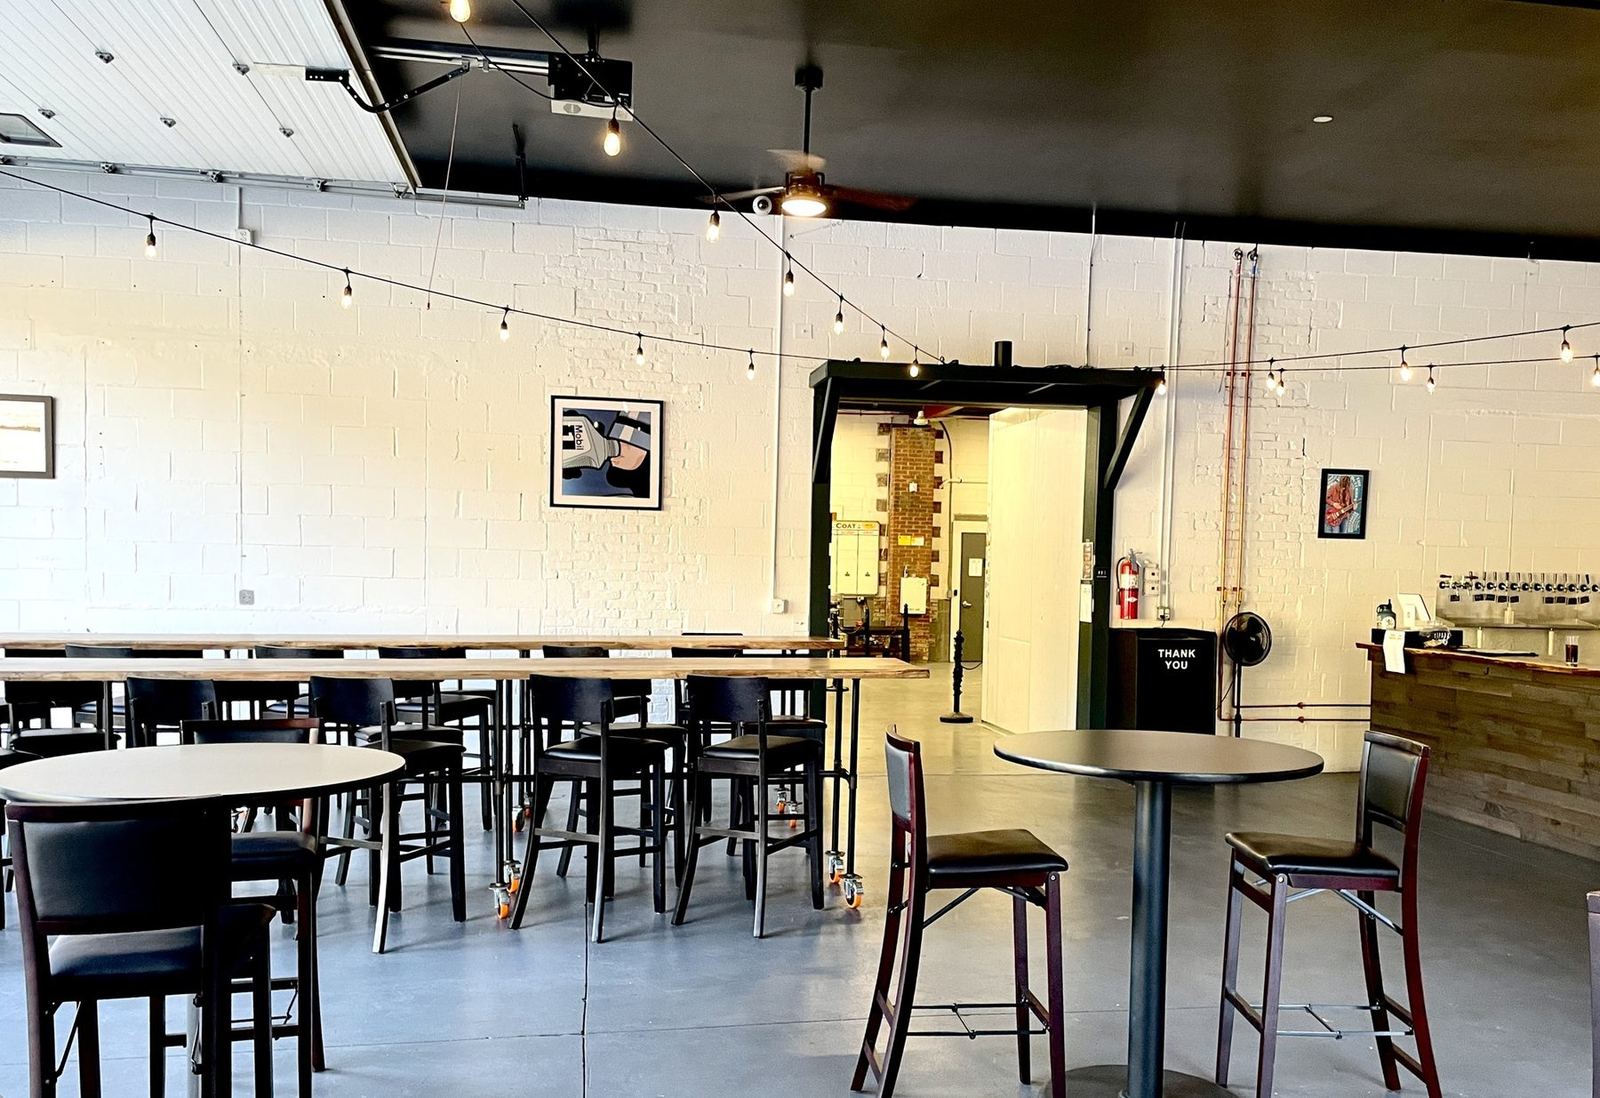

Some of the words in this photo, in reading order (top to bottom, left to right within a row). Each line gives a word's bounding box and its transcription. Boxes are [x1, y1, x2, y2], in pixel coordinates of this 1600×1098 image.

[575, 425, 584, 450] Mobil
[1157, 648, 1196, 658] THANK
[1164, 660, 1188, 670] YOU
